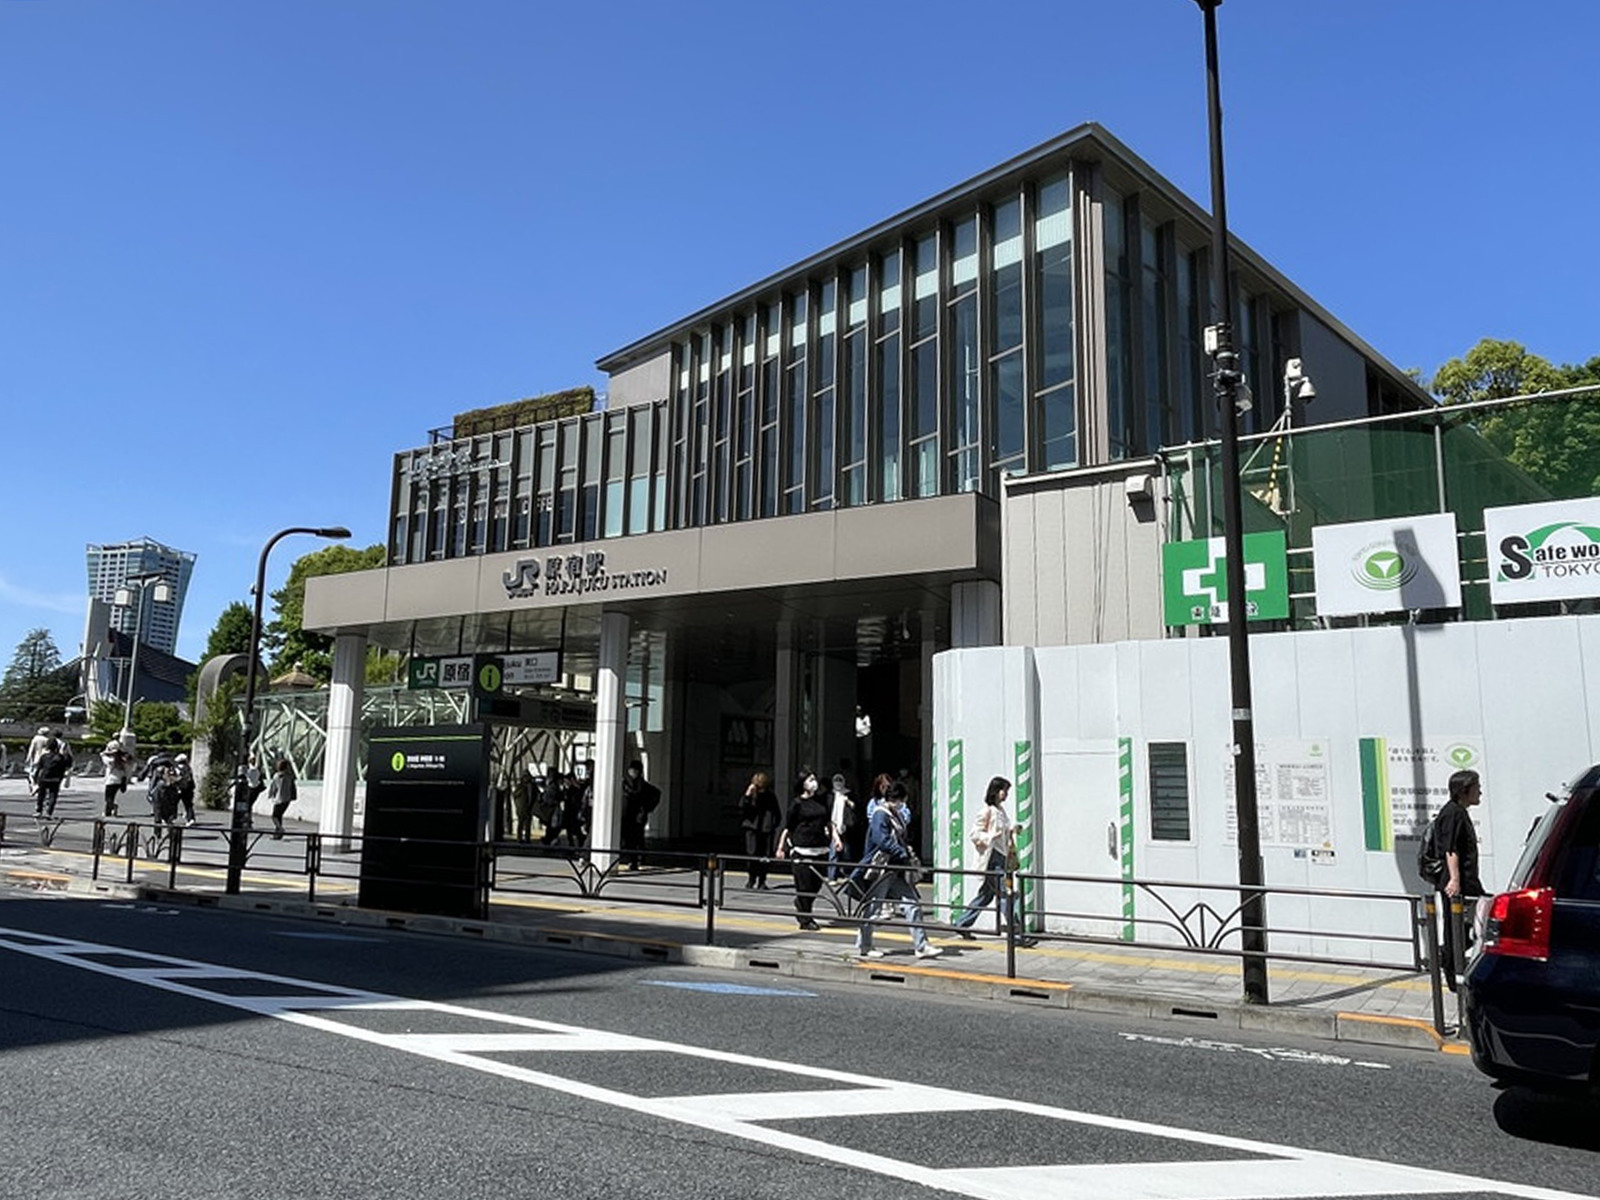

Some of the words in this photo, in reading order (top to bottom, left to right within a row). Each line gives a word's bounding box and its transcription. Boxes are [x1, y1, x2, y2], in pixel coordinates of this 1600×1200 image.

[545, 551, 606, 581] 原宿駅
[1499, 535, 1567, 580] Safe
[502, 559, 540, 590] JR
[611, 569, 668, 590] STATION
[416, 662, 437, 680] JR
